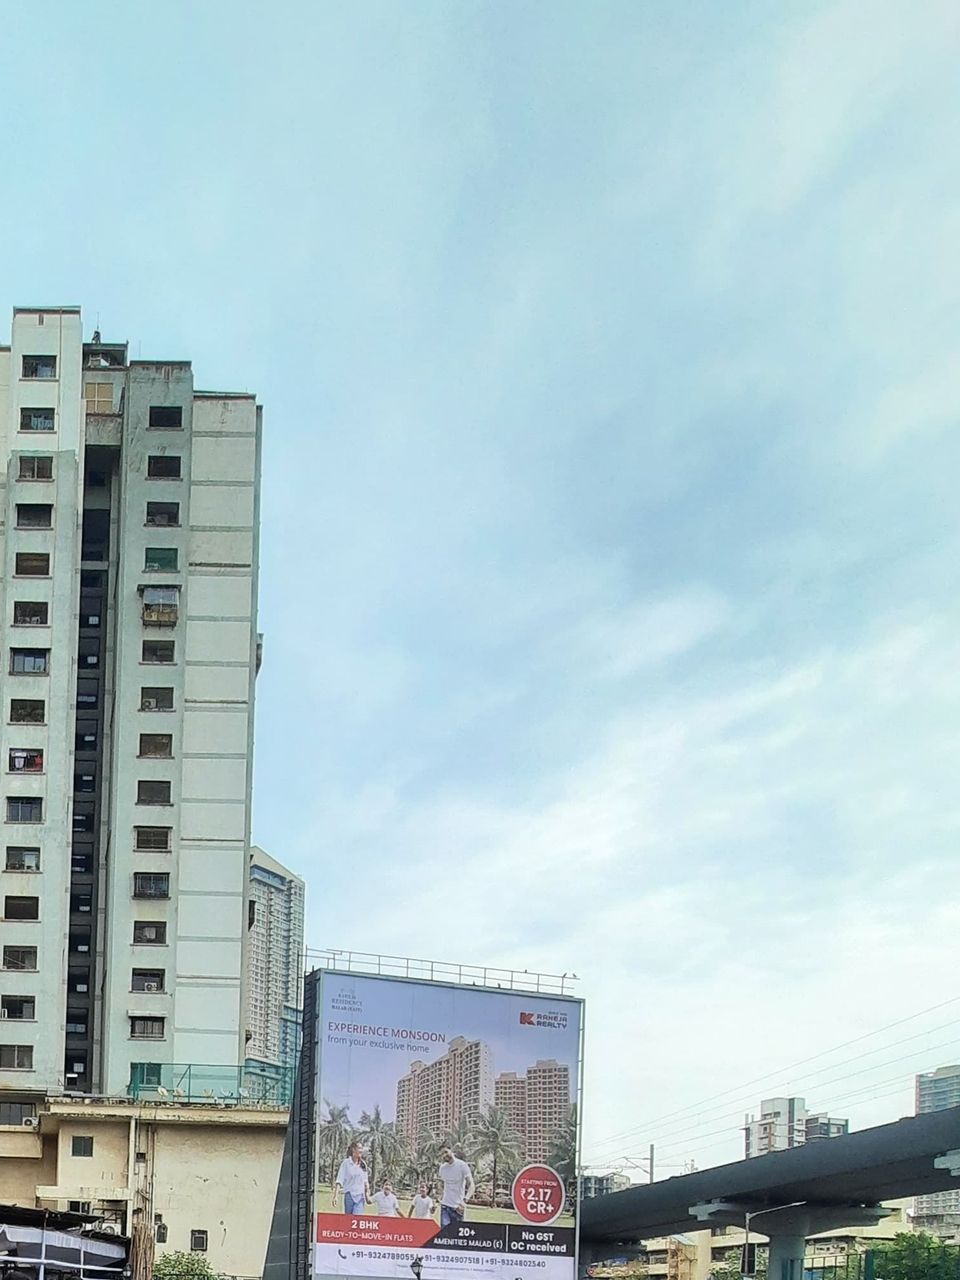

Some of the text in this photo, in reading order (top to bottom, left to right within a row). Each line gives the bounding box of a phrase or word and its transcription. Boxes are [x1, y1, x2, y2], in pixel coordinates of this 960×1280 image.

[536, 1020, 568, 1030] REALTY
[328, 1021, 446, 1043] EXPERIENCE MONSOON
[327, 1034, 430, 1054] from your exclusive home
[520, 1187, 552, 1202] ₹2.17
[527, 1200, 555, 1214] CR+
[351, 1220, 380, 1230] 2 BHK
[458, 1227, 476, 1237] 20+
[522, 1231, 554, 1241] No GST
[393, 1234, 414, 1242] FLATS
[433, 1238, 468, 1248] AMENITIES
[468, 1240, 492, 1249] MALAD
[510, 1241, 567, 1253] OC received
